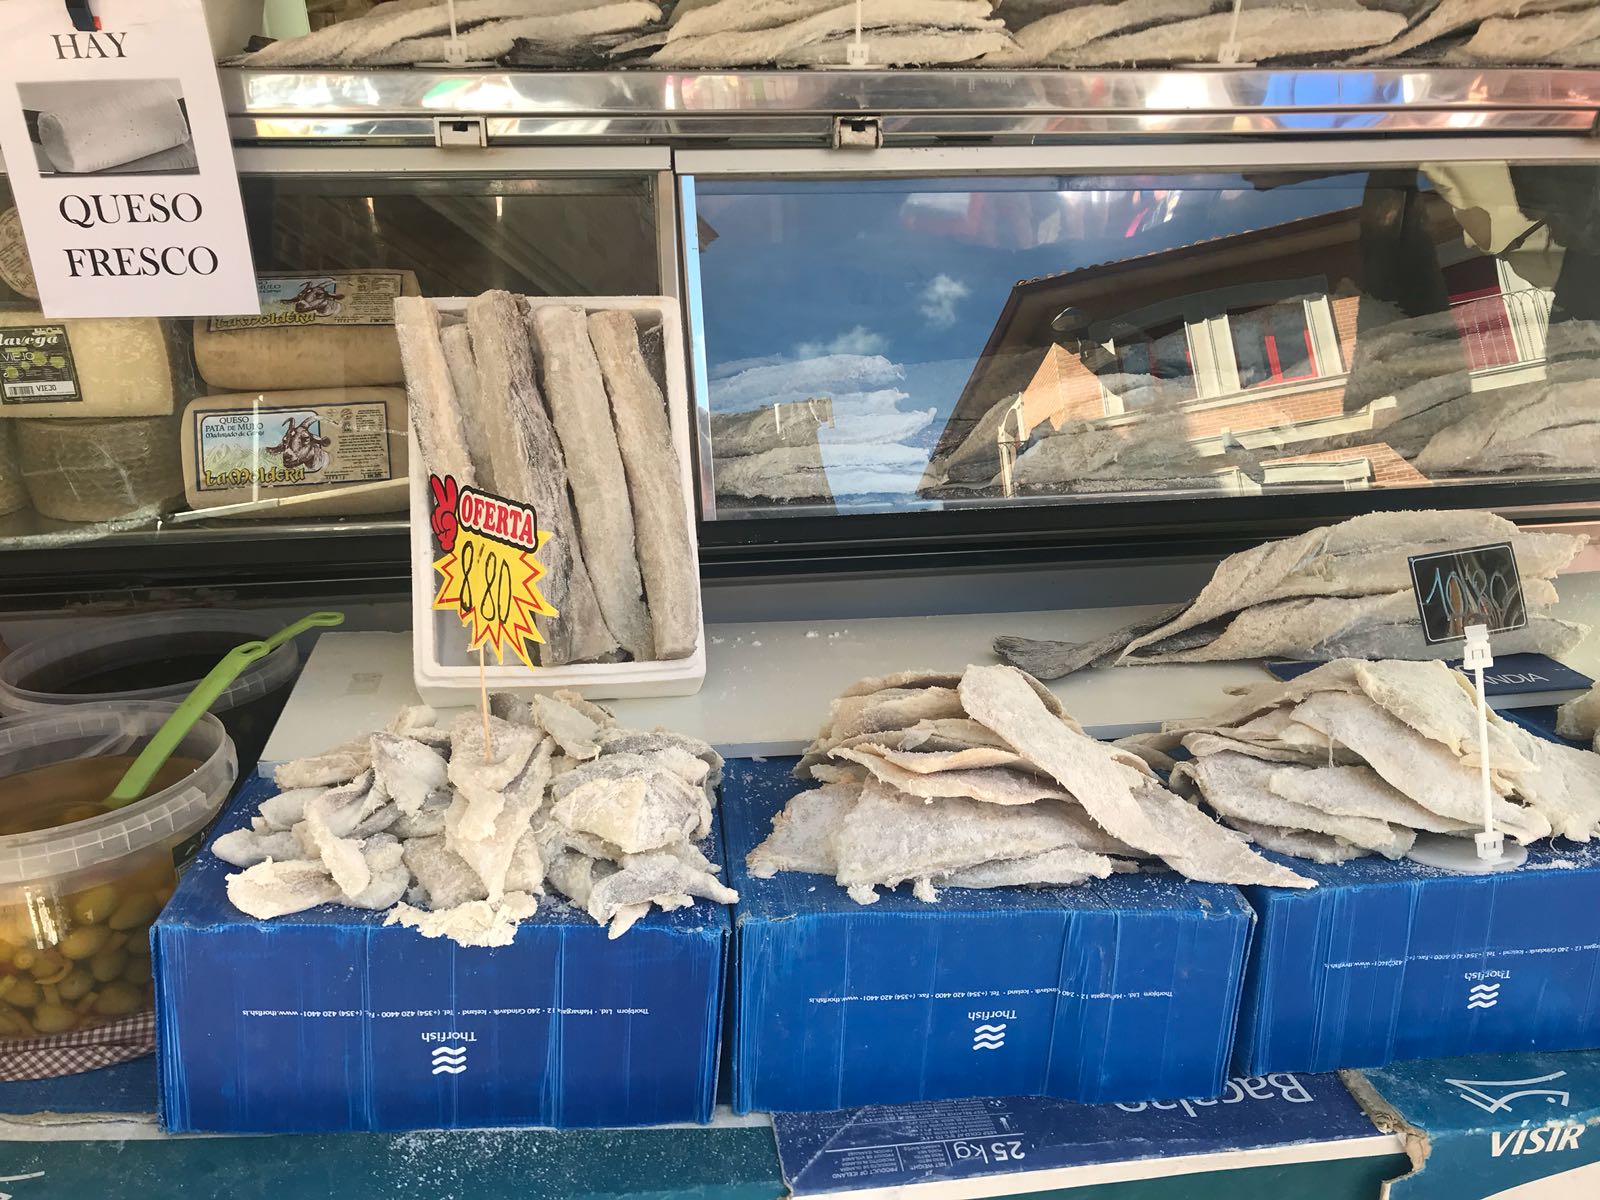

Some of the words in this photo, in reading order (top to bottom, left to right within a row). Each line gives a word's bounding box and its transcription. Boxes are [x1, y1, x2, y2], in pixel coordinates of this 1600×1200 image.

[51, 31, 127, 60] HAY
[59, 192, 203, 229] QUESO
[62, 245, 219, 278] FRESCO
[1, 351, 34, 362] VIEJO
[36, 384, 57, 392] VIEJO
[219, 415, 250, 426] QUESO
[205, 424, 225, 433] PATA
[461, 493, 535, 546] OFERTA
[459, 540, 513, 625] 8'80
[1464, 970, 1511, 982] Thorfish
[1061, 990, 1075, 998] 240
[242, 1009, 299, 1017] www.thorfish.is
[303, 1010, 322, 1018] 4401
[338, 1009, 363, 1017] (+354)
[416, 1009, 441, 1017] (+354)
[527, 1007, 541, 1015] 240
[599, 1008, 613, 1016] Ltd.
[968, 1009, 1017, 1022] Thorfish
[421, 1031, 478, 1043] Thorfish
[953, 1141, 989, 1164] kg
[991, 1140, 1026, 1161] 25
[831, 1171, 859, 1179] ICELAND
